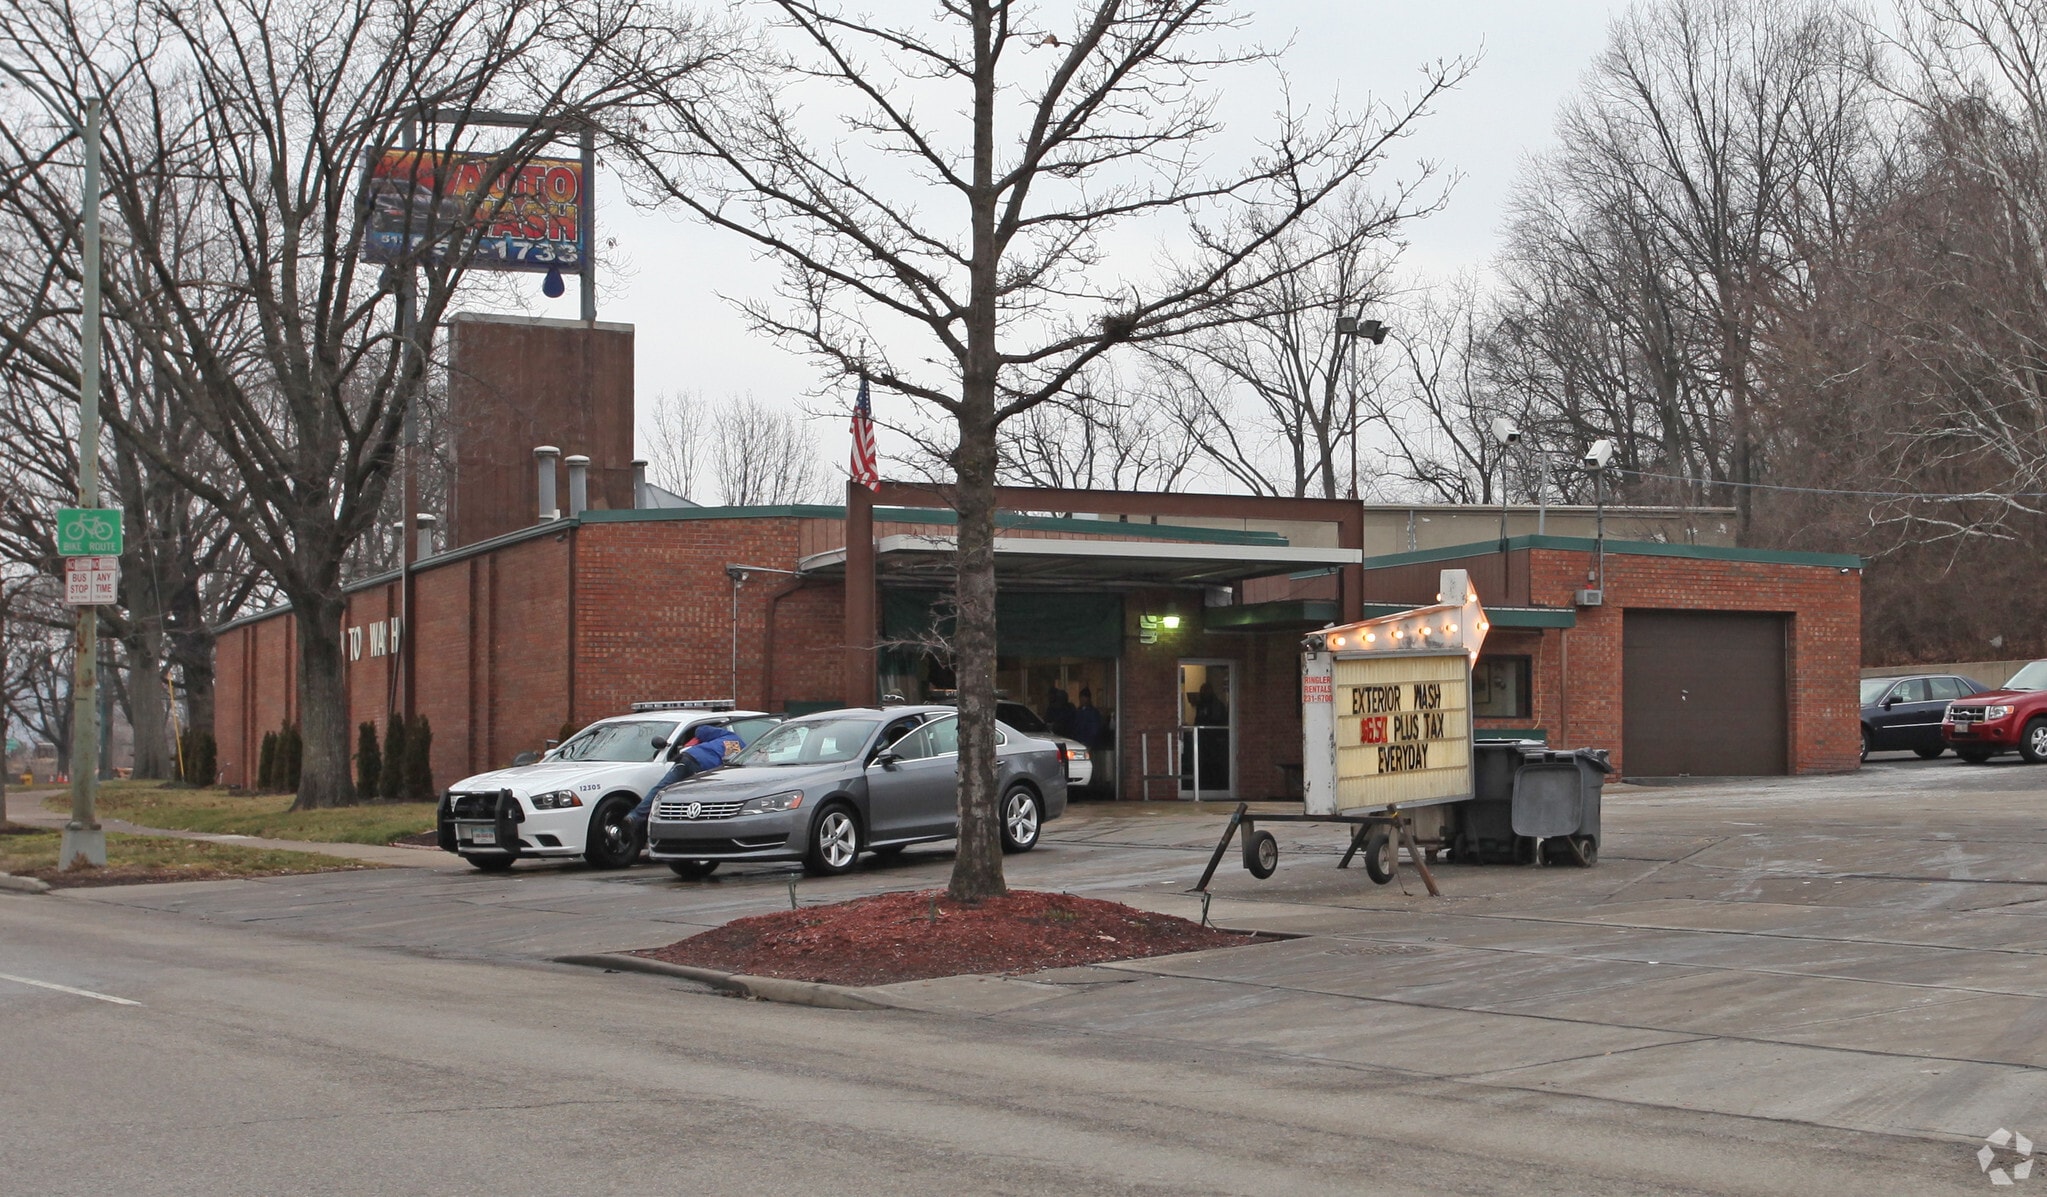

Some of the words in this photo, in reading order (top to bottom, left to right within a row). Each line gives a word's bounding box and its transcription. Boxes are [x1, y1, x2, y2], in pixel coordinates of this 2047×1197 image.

[454, 161, 578, 203] AUTO
[63, 542, 82, 551] BIKE
[89, 542, 116, 551] ROUTE
[72, 573, 87, 582] BUS
[96, 573, 112, 581] ANY
[70, 584, 89, 593] STOP
[95, 584, 112, 592] TIME
[1303, 676, 1332, 684] RINGLER
[1303, 685, 1333, 693] RENTALS
[1352, 685, 1401, 714] EXTERIOR
[1413, 683, 1441, 710] WASH
[1394, 714, 1419, 741] PLUS
[1423, 713, 1444, 739] TAX
[1378, 743, 1428, 773] EVERYDAY
